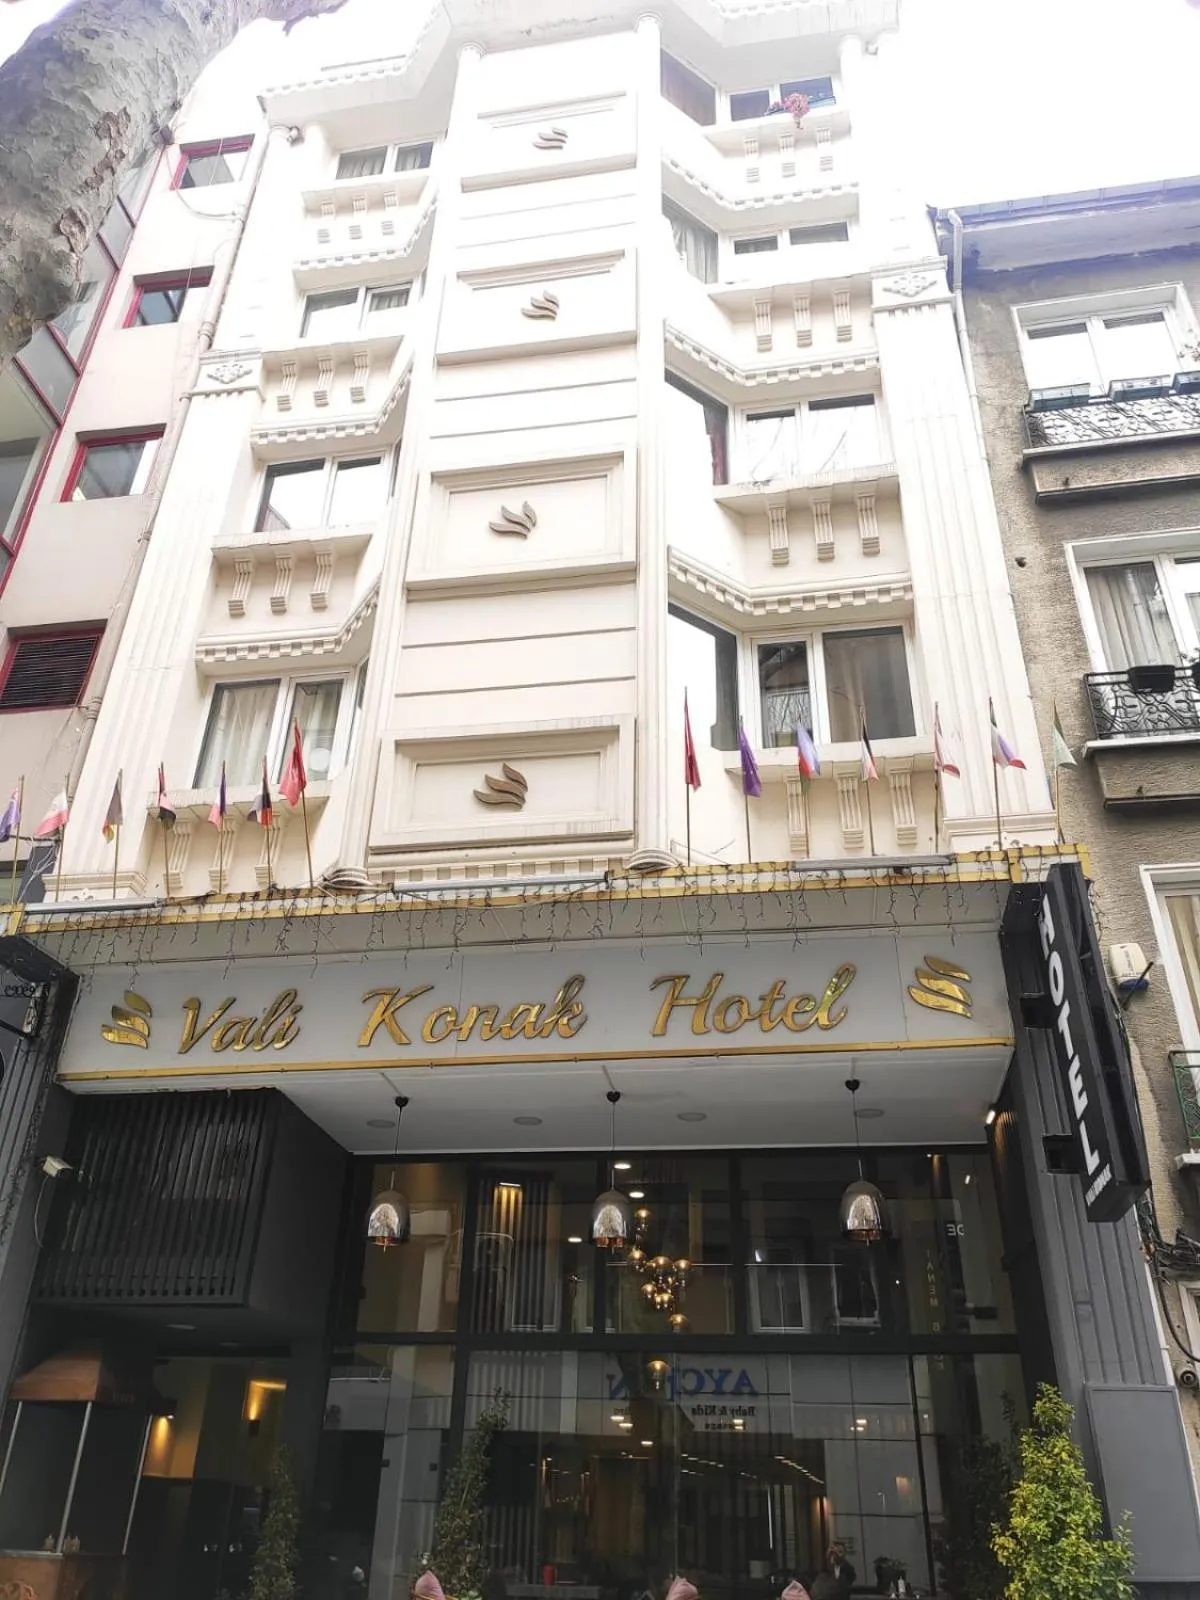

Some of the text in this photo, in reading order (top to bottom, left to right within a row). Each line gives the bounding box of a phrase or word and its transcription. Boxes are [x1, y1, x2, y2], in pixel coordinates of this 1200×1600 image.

[178, 963, 856, 1054] Vali Konak Hotel
[1040, 893, 1100, 1172] HOTEL
